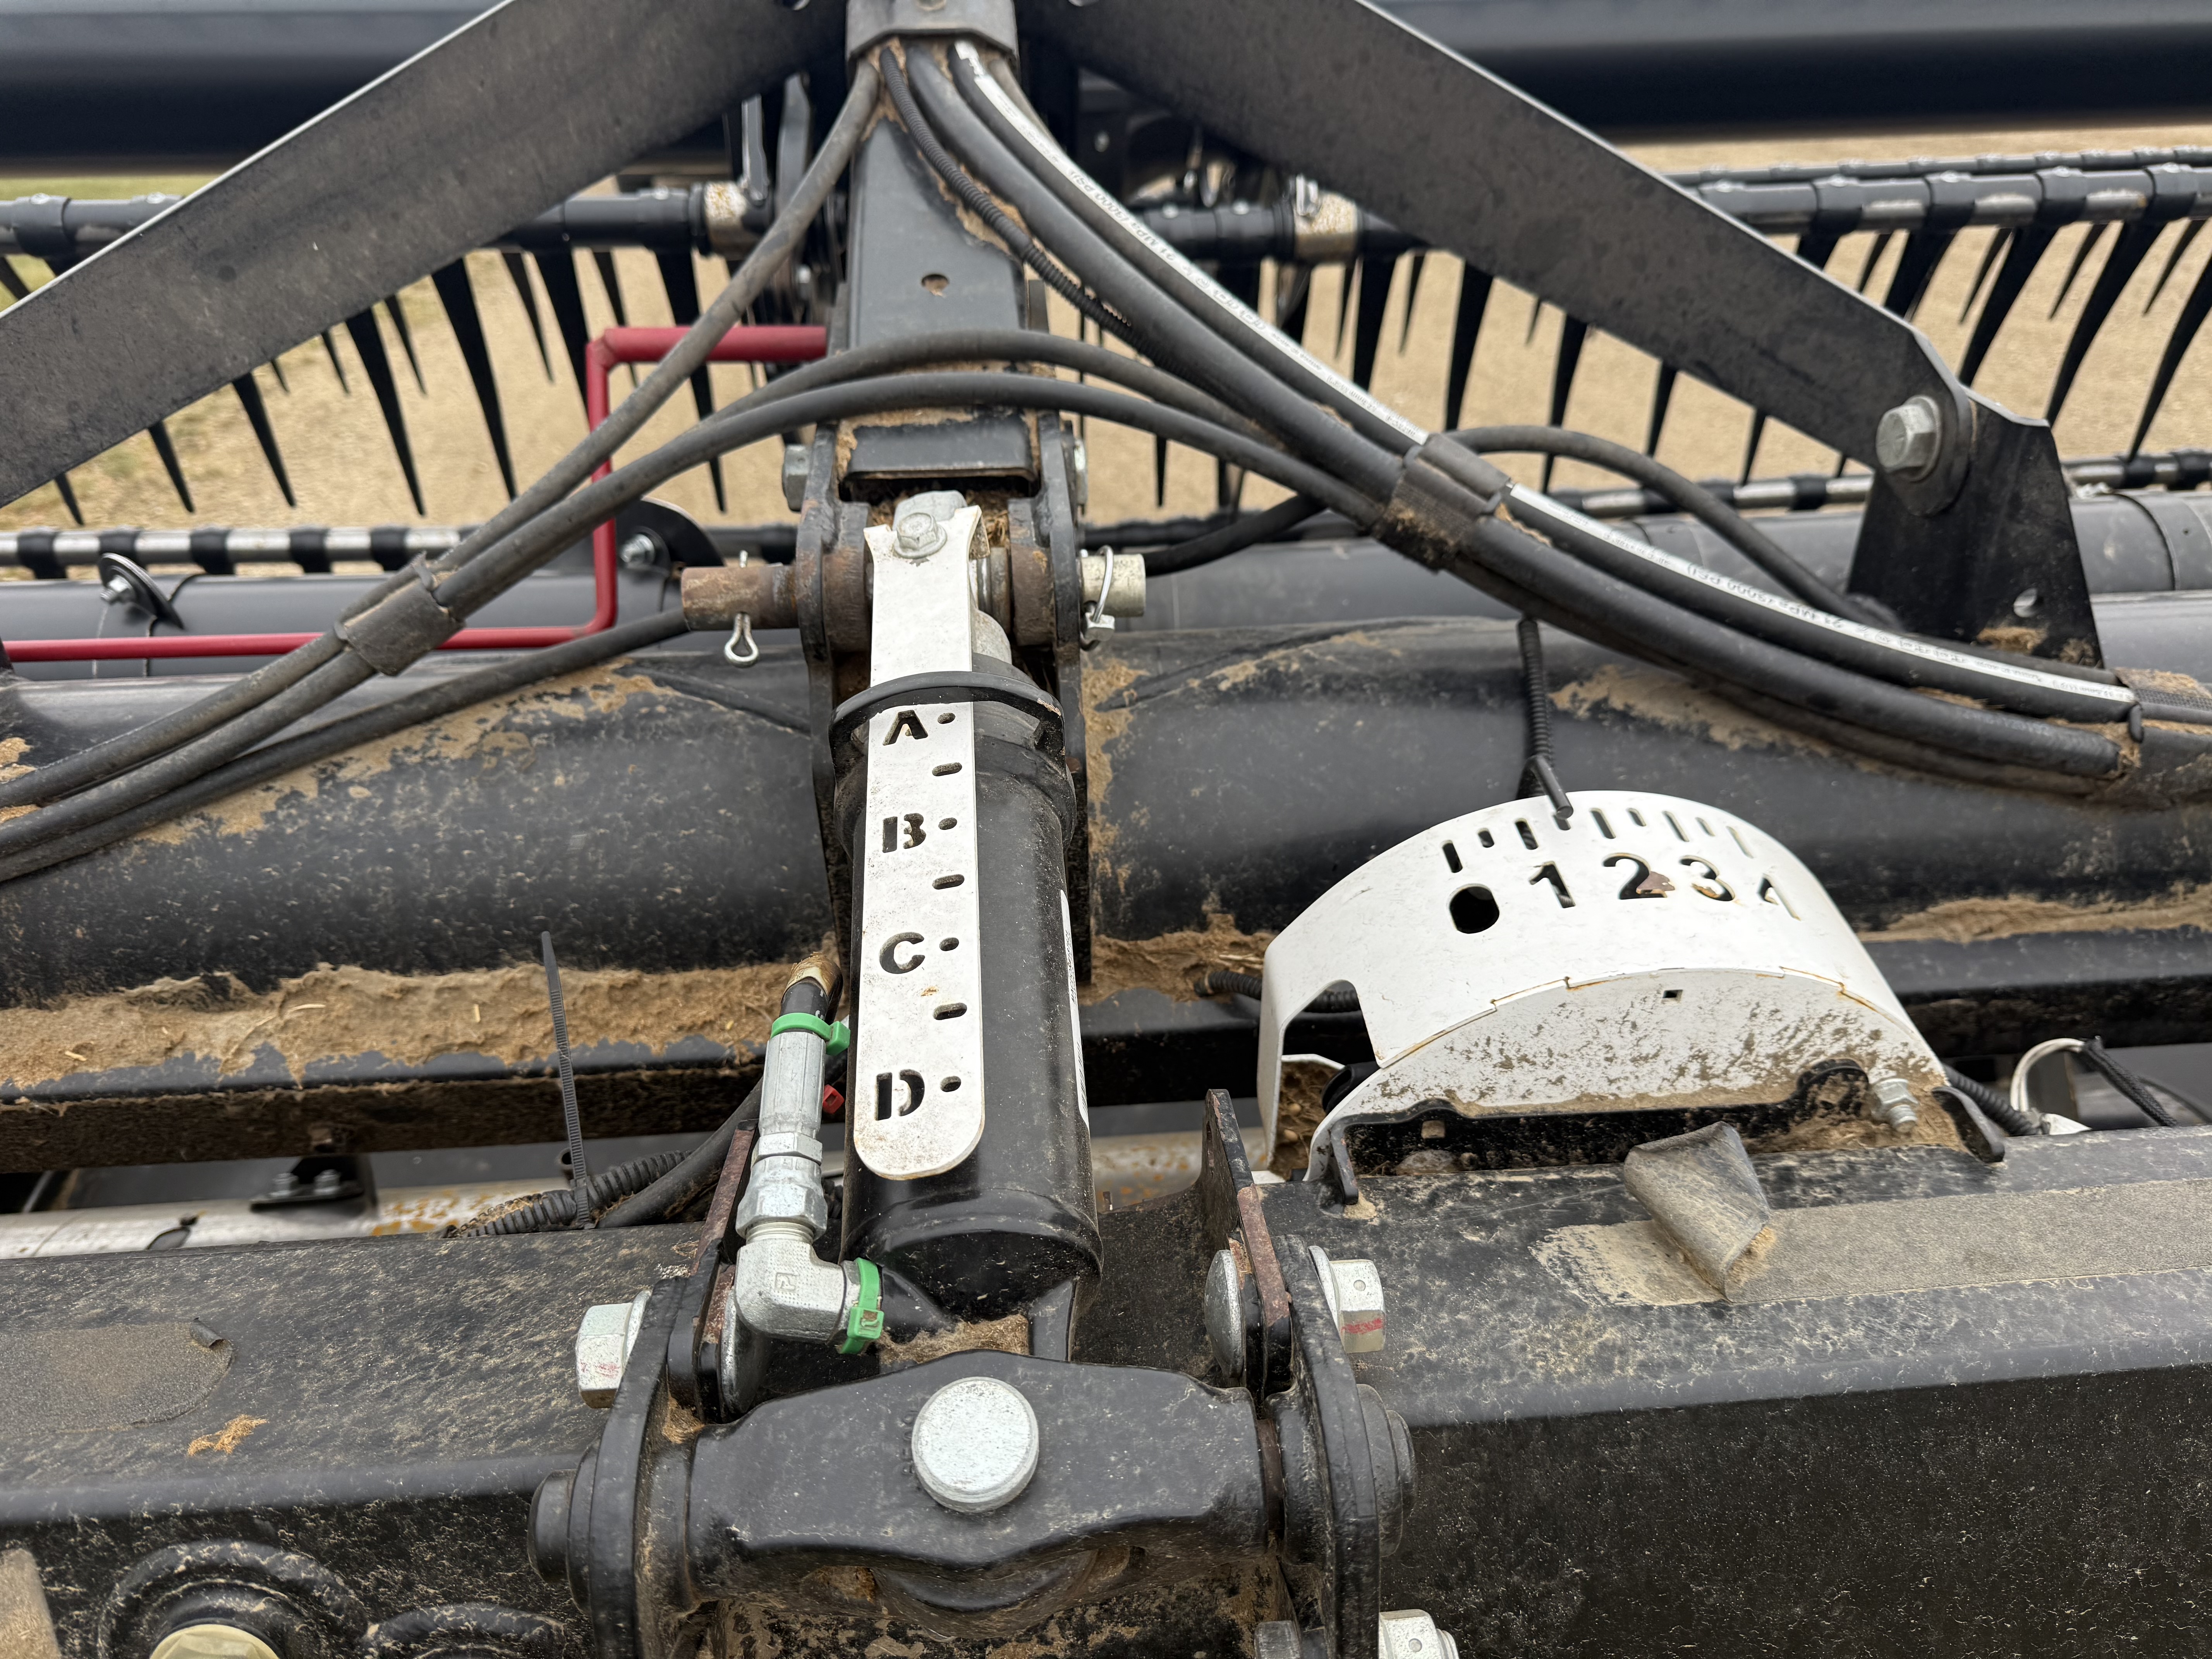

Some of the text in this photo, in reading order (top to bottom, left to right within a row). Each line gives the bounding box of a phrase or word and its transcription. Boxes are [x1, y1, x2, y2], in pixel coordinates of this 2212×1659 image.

[1129, 222, 1159, 248] MPa
[1779, 600, 1817, 620] MPa
[882, 709, 929, 746] A
[882, 812, 927, 853] B
[1529, 860, 1576, 908] 1
[1602, 852, 1667, 900] 2
[1678, 855, 1736, 902] 3
[879, 932, 926, 974] C
[874, 1069, 925, 1121] D
